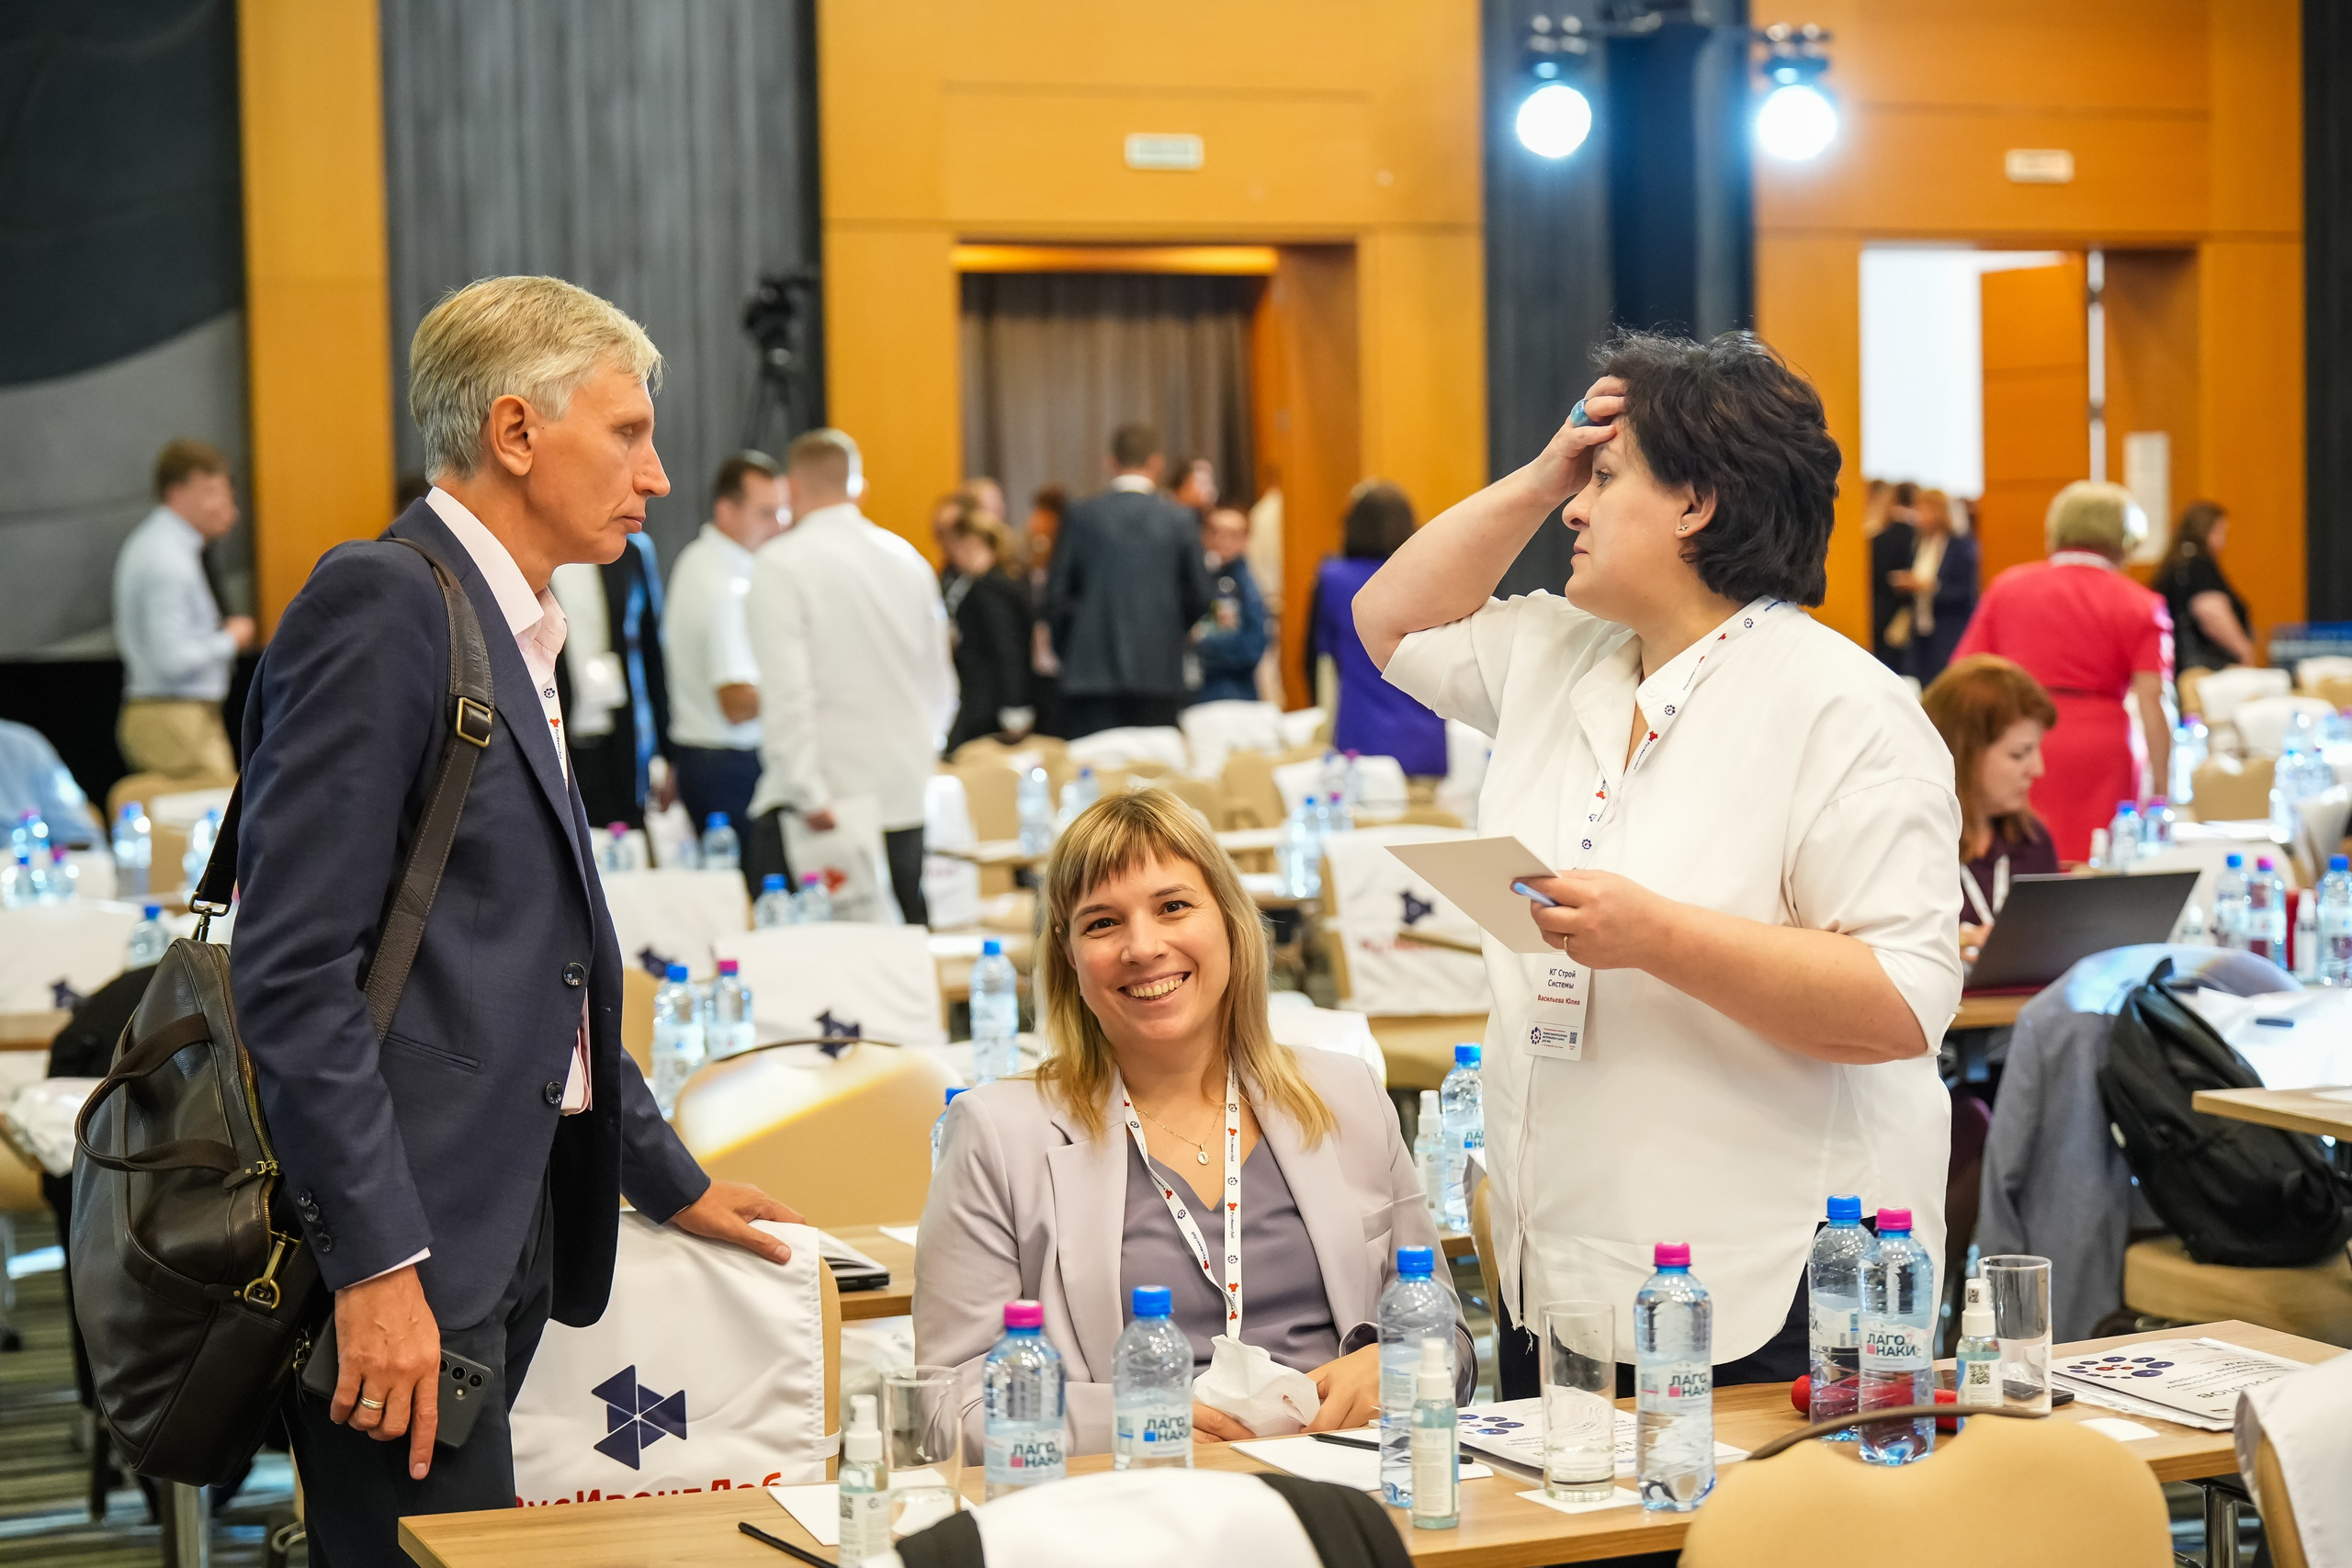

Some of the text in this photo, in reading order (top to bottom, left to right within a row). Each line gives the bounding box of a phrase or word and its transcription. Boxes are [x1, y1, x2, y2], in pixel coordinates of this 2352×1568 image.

[1549, 968, 1577, 979] КГ Строй
[1548, 979, 1575, 989] Системы
[1537, 994, 1580, 1006] Васильева Юлия
[1867, 1333, 1905, 1346] ЛАГО
[1876, 1345, 1917, 1357] НАКИ
[1668, 1372, 1707, 1386] ЛАГО
[1144, 1416, 1185, 1430] ЛАГО
[1011, 1441, 1056, 1457] ЛАГО
